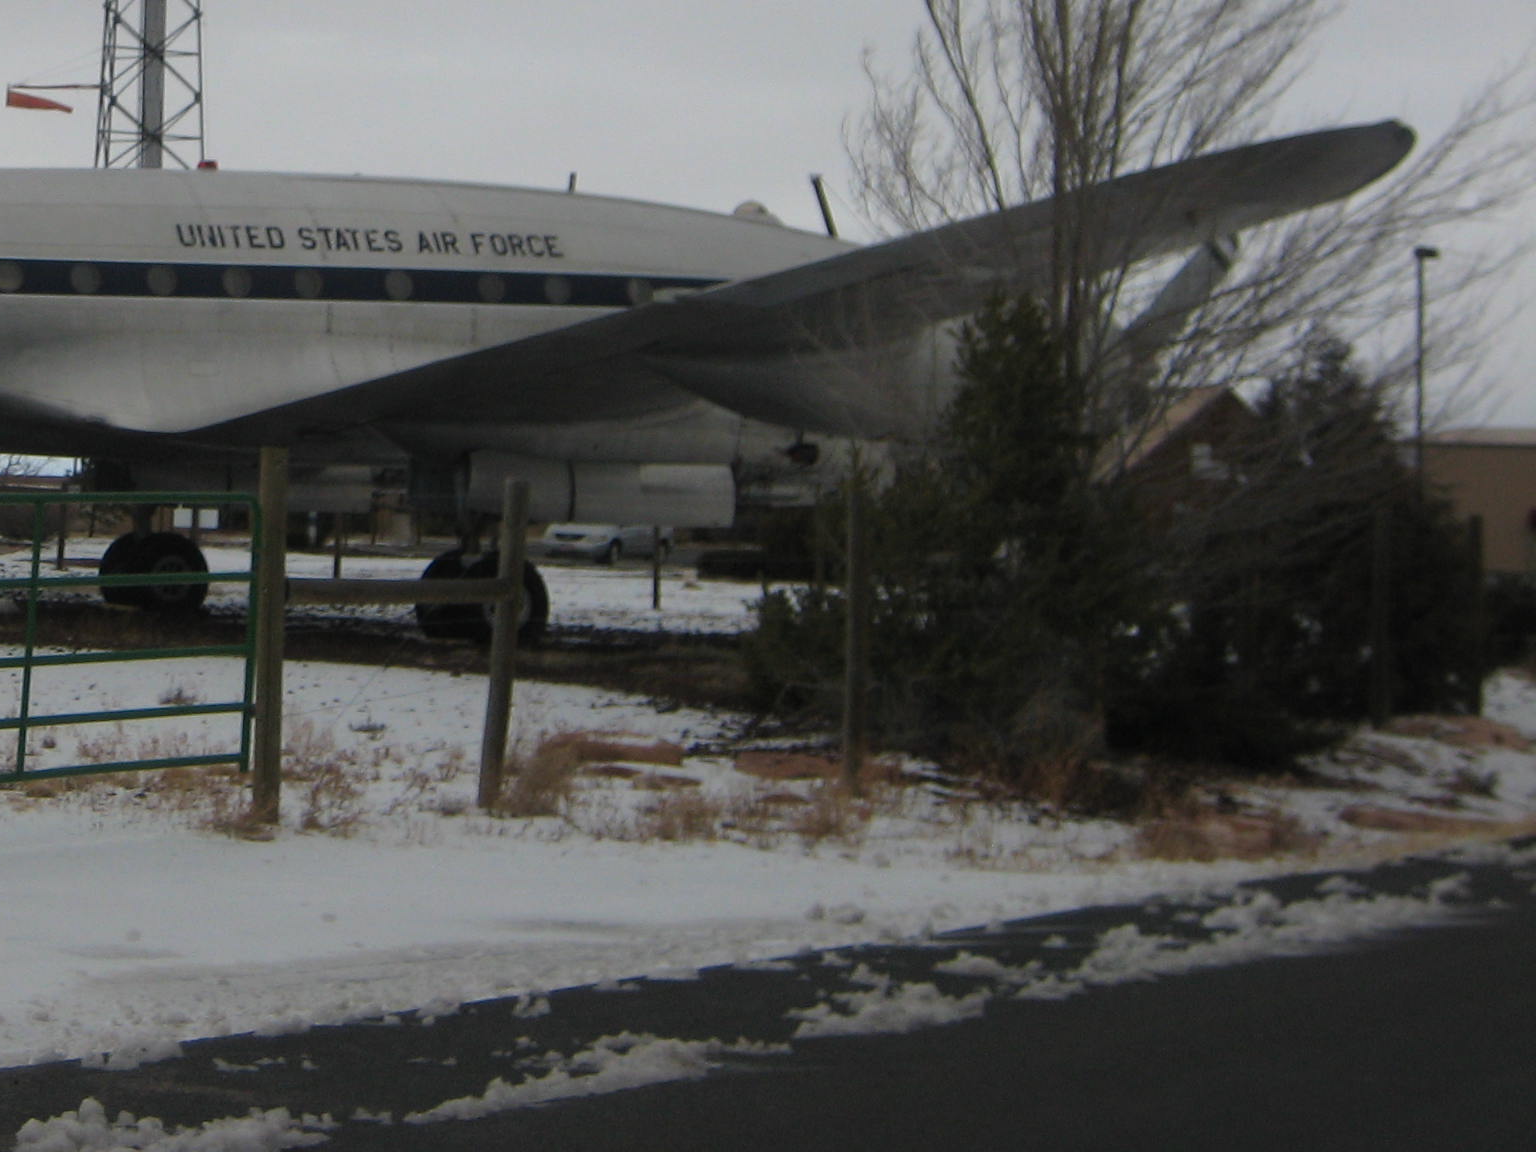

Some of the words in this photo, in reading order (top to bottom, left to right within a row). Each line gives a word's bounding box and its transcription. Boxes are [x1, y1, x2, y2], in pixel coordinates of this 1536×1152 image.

[176, 224, 286, 250] UNITED
[297, 227, 403, 253] STATES
[417, 231, 462, 255] AIR
[471, 233, 564, 258] FORCE
